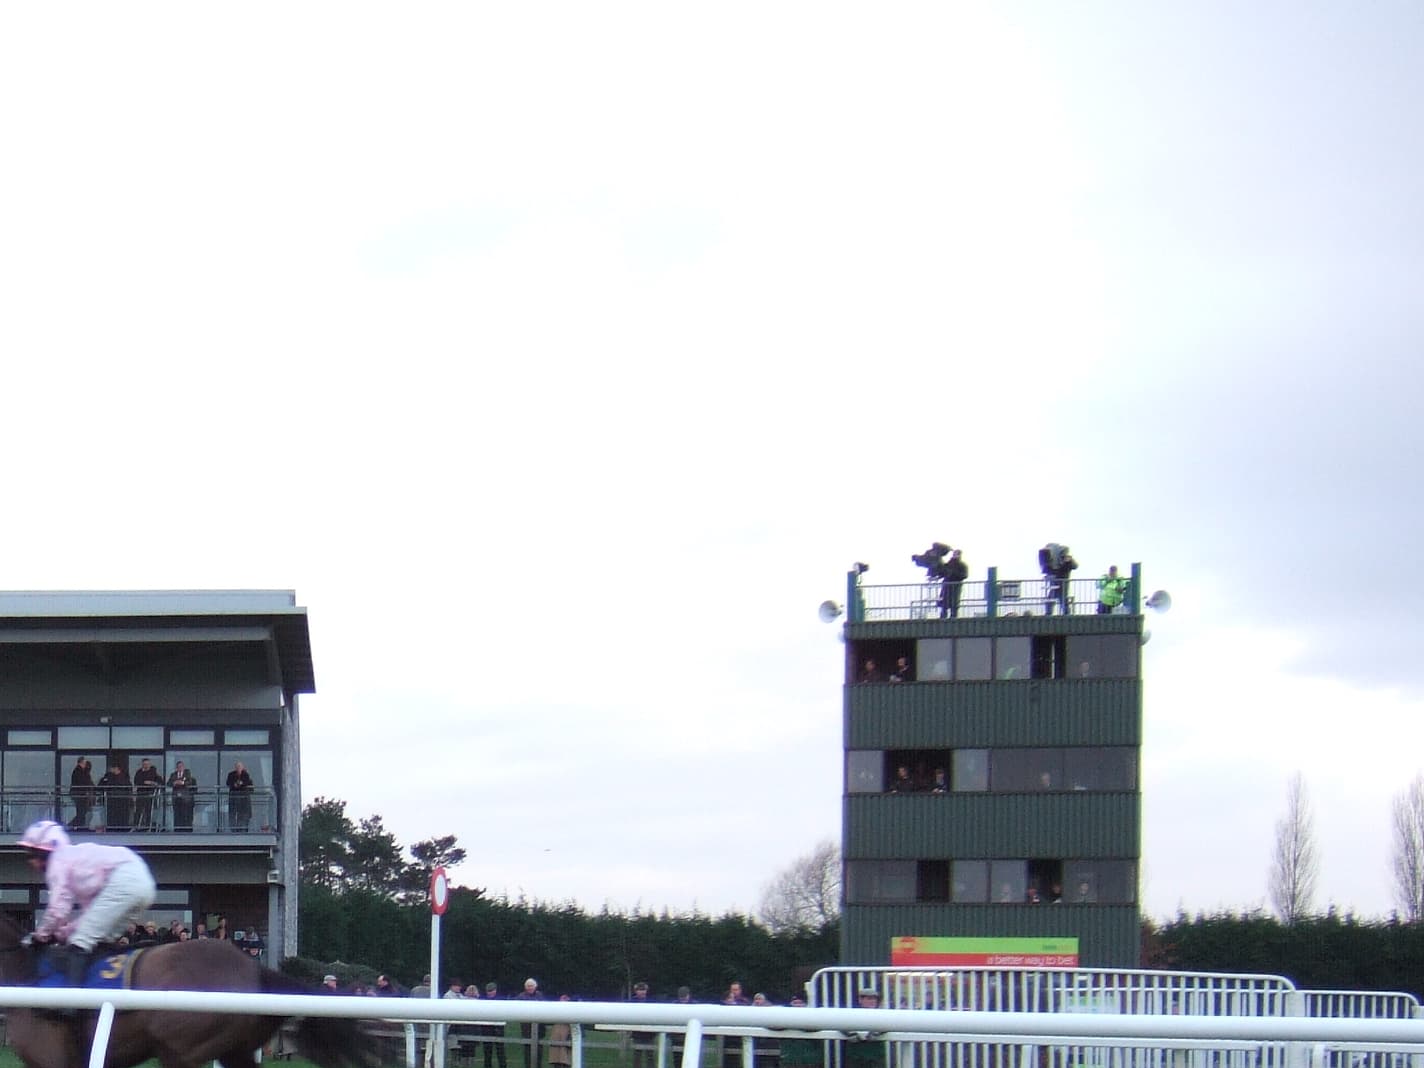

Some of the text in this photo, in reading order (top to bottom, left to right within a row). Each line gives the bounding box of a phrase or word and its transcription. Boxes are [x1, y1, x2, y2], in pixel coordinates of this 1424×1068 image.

[995, 954, 1024, 965] better
[1025, 956, 1044, 967] way
[1045, 955, 1056, 965] to
